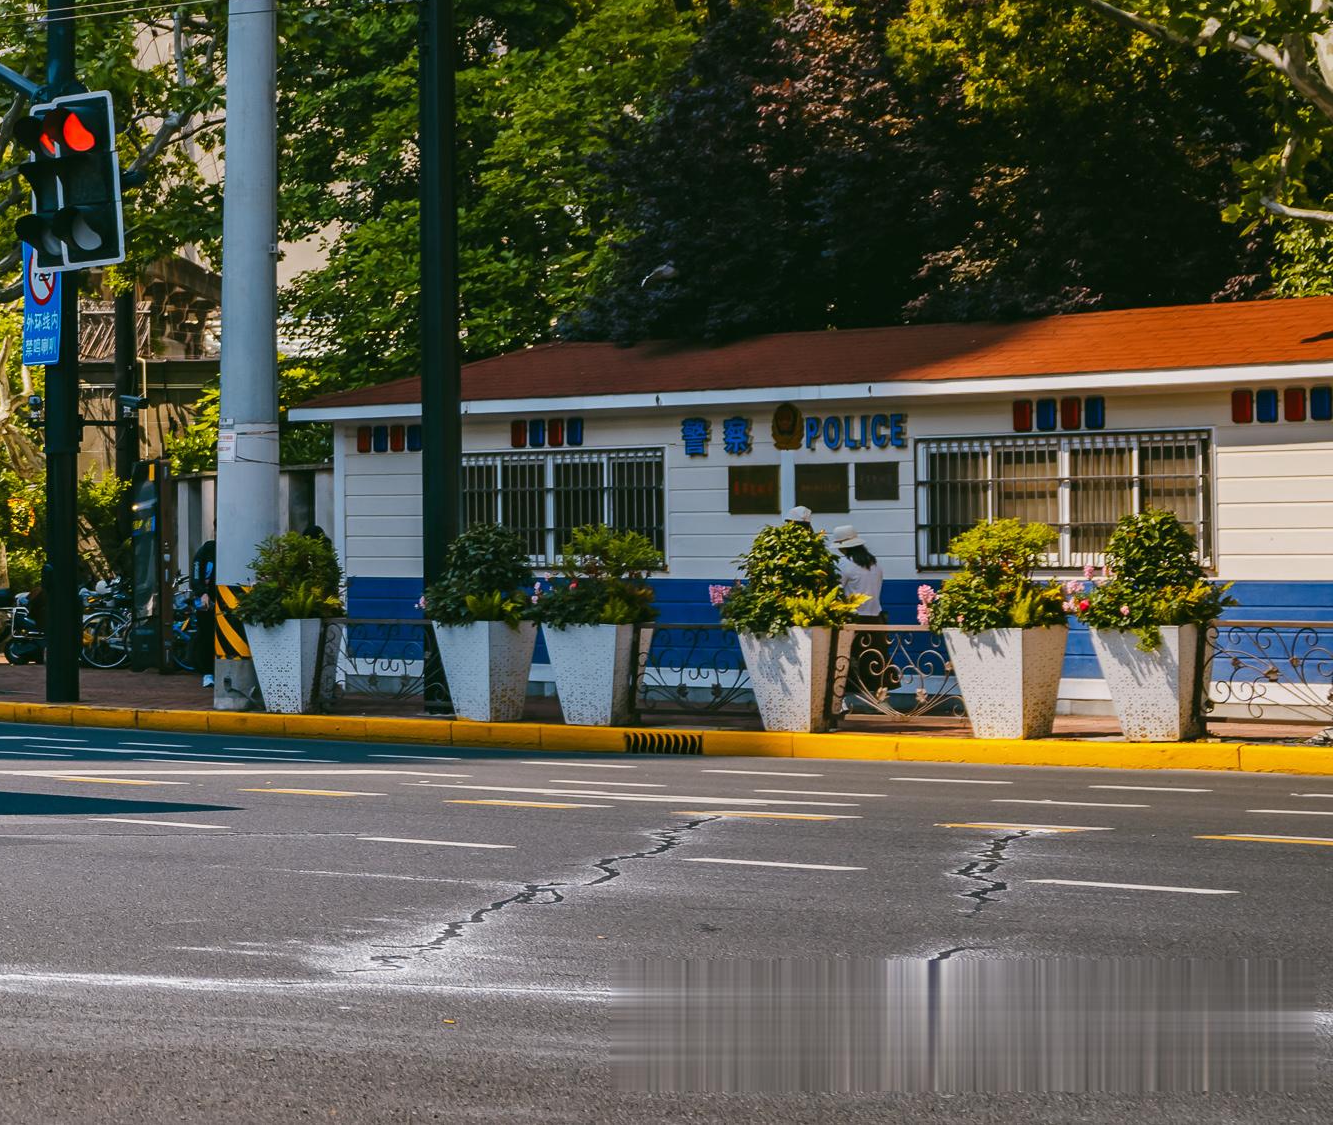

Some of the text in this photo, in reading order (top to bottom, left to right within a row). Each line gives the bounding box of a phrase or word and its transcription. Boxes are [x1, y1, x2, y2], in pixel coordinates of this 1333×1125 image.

[26, 311, 59, 332] 外环线内
[25, 337, 57, 358] 禁鸣喇叭
[681, 416, 753, 457] 警察
[805, 413, 909, 450] POLICE
